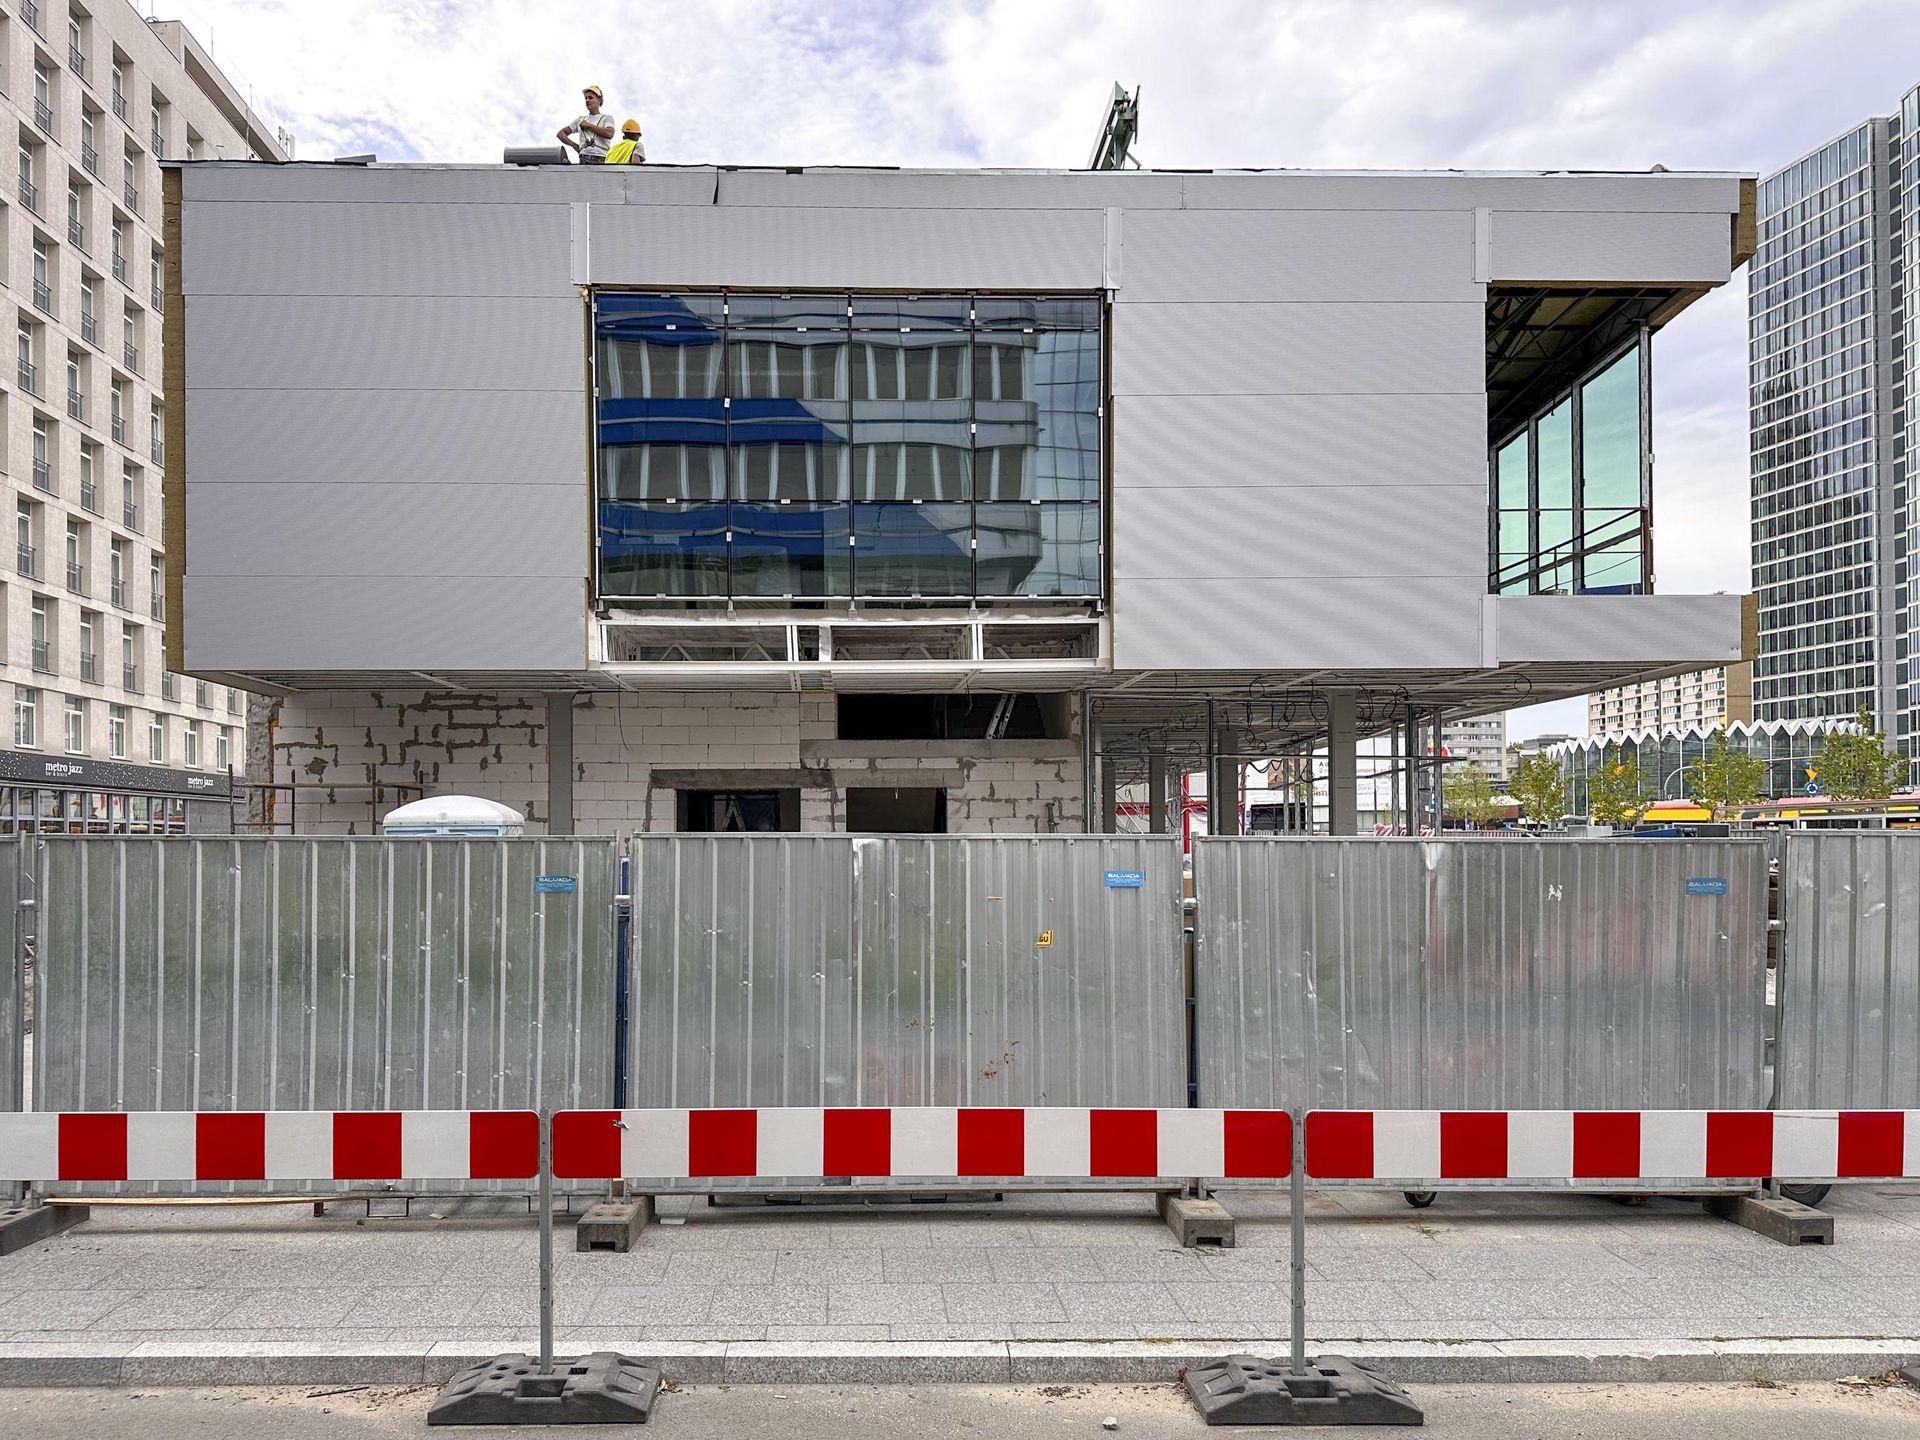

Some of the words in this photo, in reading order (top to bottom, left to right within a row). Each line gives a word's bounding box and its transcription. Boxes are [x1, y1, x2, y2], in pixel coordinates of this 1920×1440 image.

[45, 762, 68, 772] metro
[68, 762, 83, 775] jazz
[187, 777, 203, 785] metro
[203, 776, 214, 788] jazz
